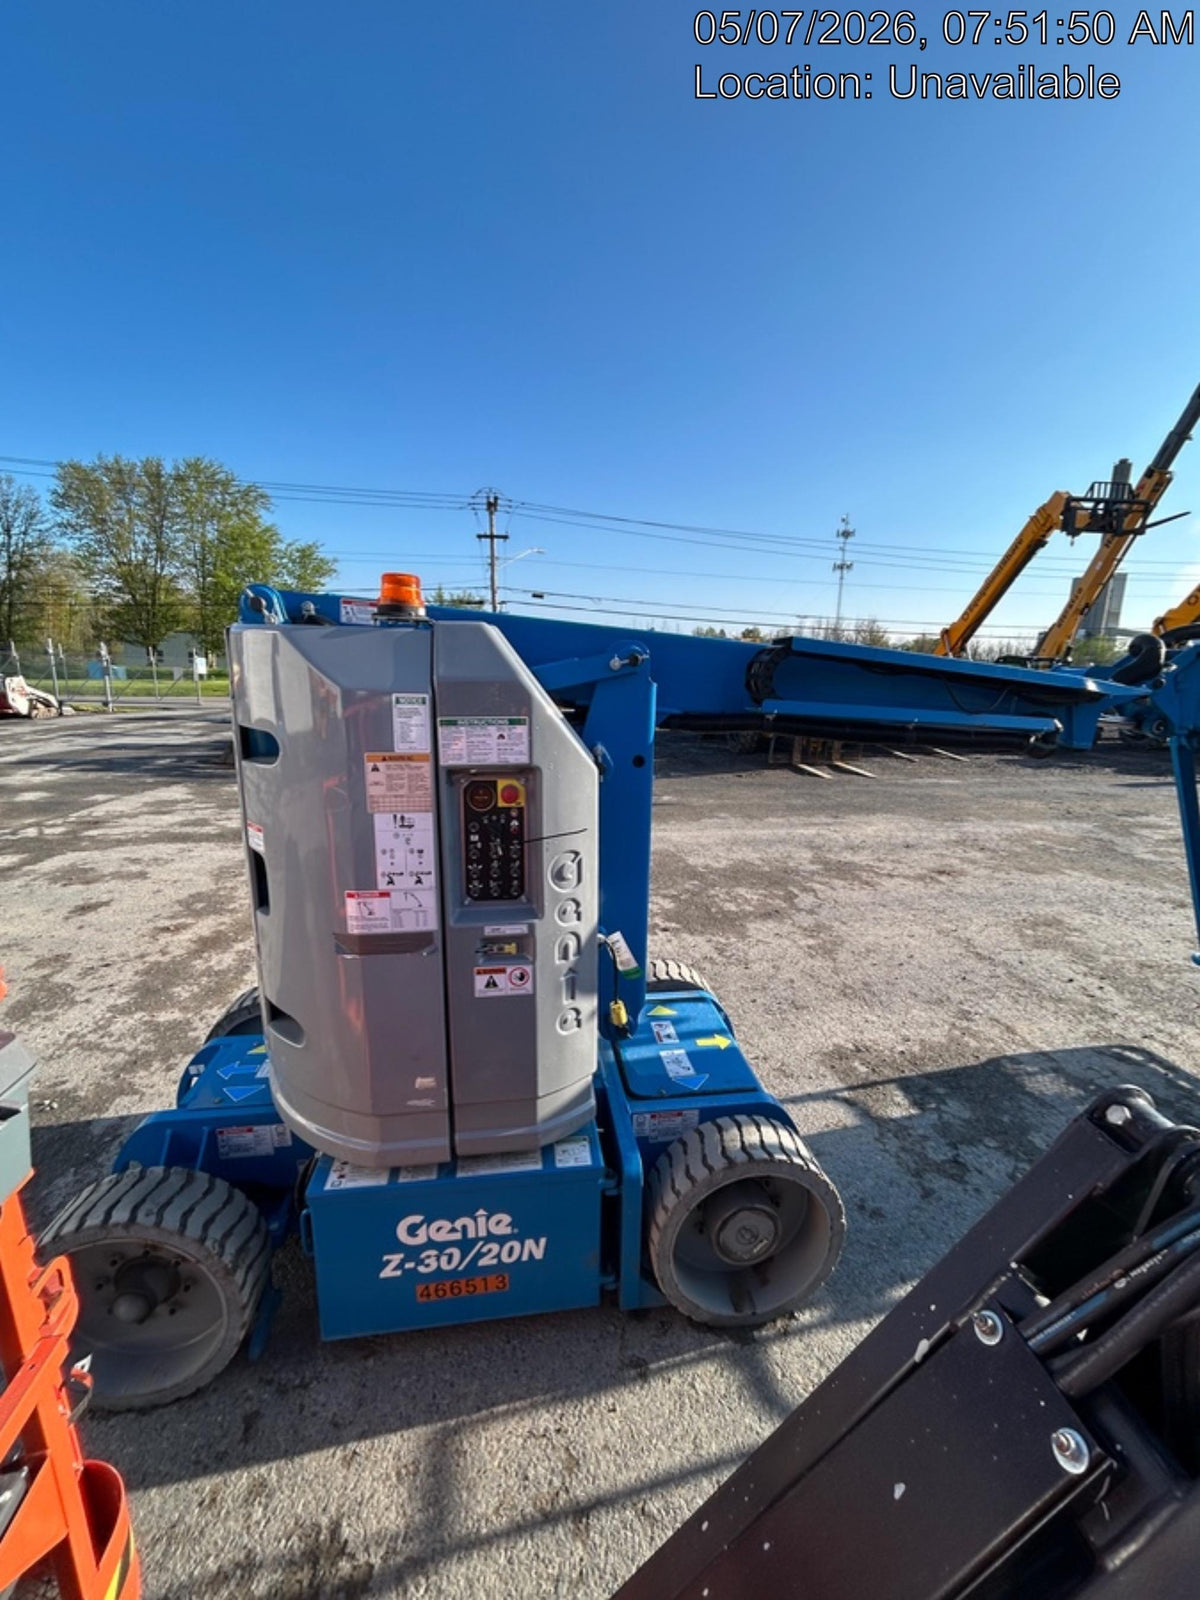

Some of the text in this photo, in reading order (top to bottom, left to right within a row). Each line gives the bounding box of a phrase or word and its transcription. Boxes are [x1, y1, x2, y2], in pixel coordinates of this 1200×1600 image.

[549, 850, 584, 1036] Genie
[396, 1208, 513, 1246] Genie
[379, 1237, 548, 1279] Z-30/20N
[418, 1274, 508, 1300] 466513
